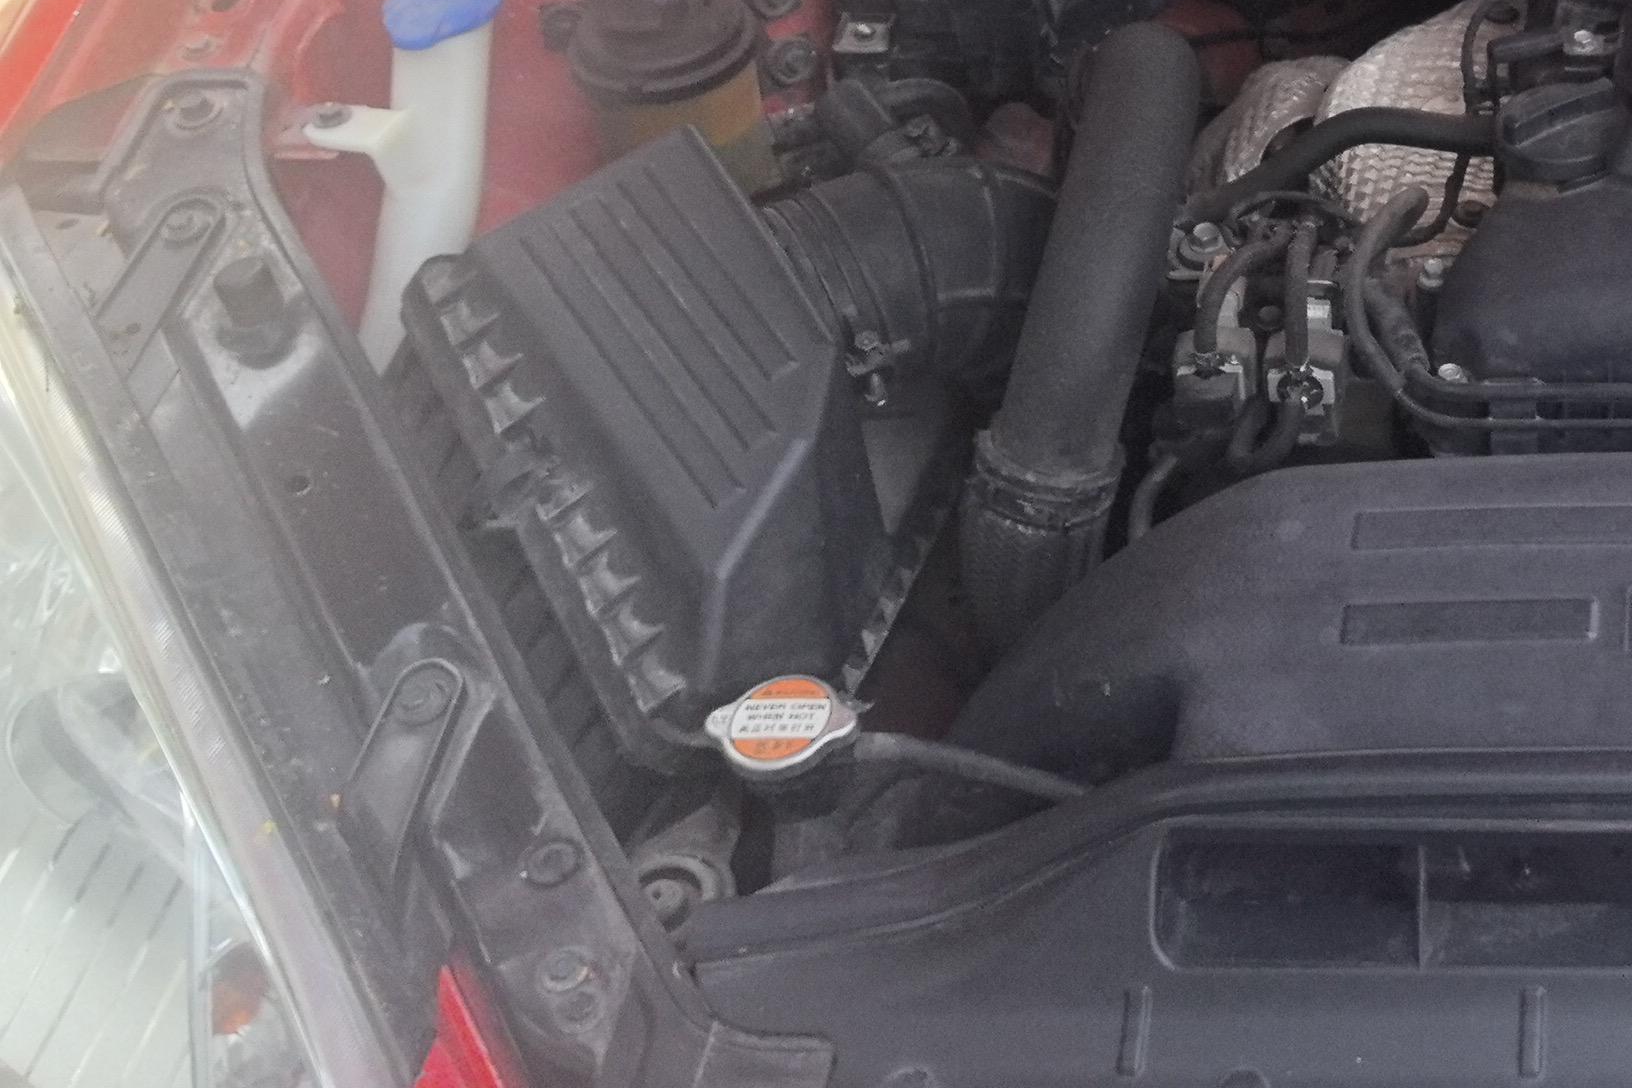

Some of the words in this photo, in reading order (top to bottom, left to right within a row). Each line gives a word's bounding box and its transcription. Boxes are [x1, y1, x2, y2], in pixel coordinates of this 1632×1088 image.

[745, 703, 786, 711] NEVER
[790, 703, 825, 711] OPEN
[788, 713, 815, 721] HOT
